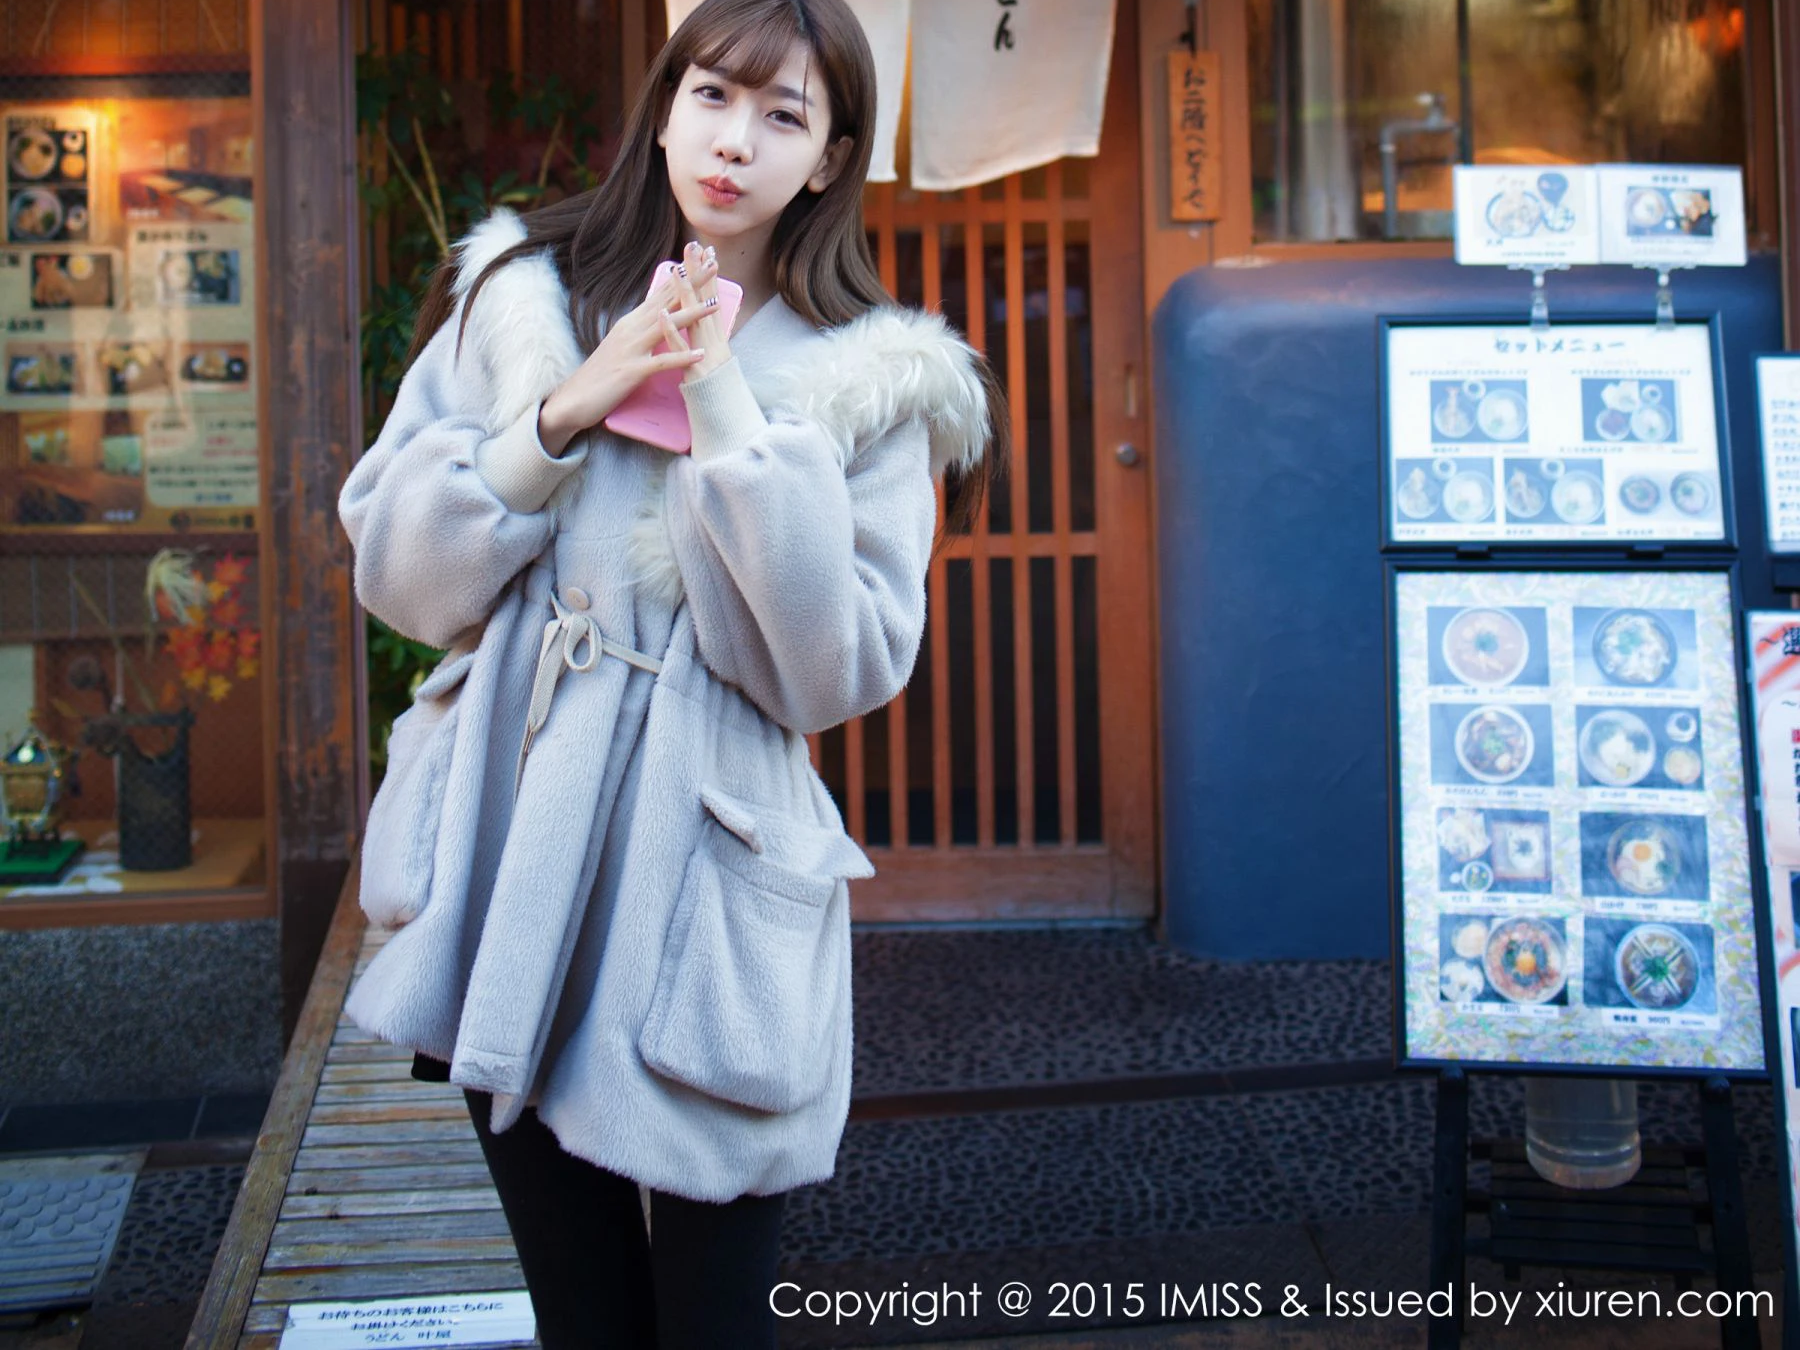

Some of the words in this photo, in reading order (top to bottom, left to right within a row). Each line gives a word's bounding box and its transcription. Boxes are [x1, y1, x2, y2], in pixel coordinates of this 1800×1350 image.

[317, 1301, 505, 1321] お待ちのお客様はこちらに
[416, 1329, 453, 1340] 叶屋
